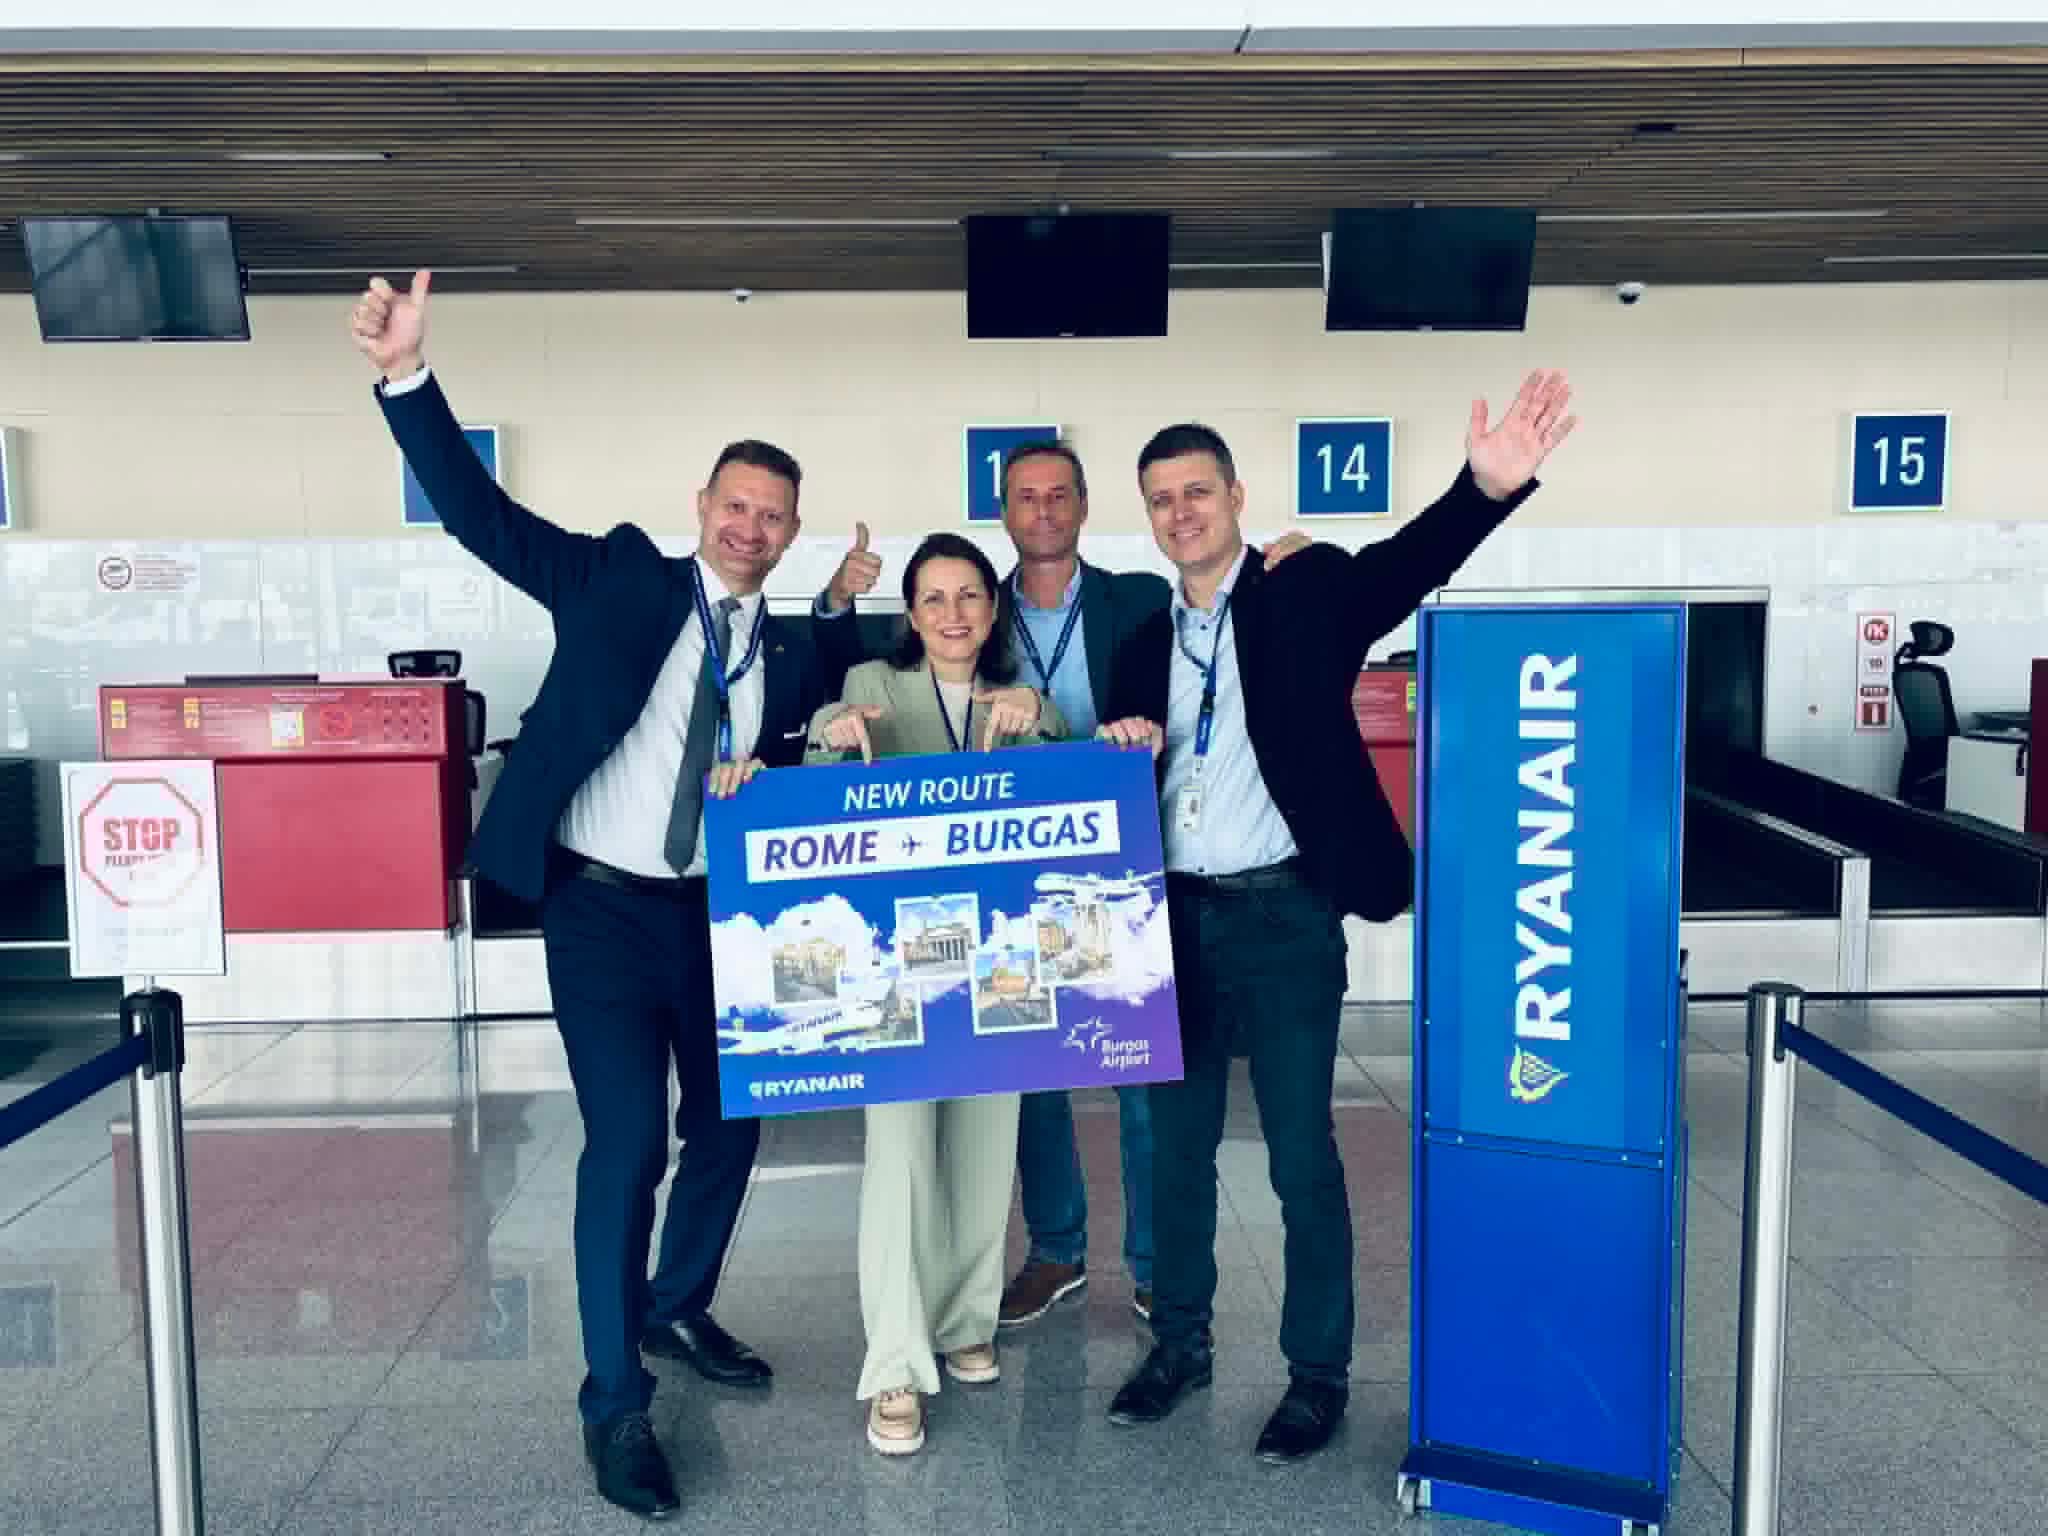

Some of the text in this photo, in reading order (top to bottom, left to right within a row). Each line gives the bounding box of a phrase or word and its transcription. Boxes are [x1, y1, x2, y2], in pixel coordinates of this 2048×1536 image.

[985, 449, 1002, 499] 1
[1317, 443, 1370, 494] 14
[1872, 436, 1926, 487] 15
[843, 771, 1015, 812] NEW ROUTE
[103, 818, 180, 850] STOP
[763, 811, 1101, 872] ROME BURGAS
[1515, 653, 1577, 1041] RYANAIR
[1100, 1054, 1151, 1071] Airport
[1102, 1039, 1150, 1056] Burgas
[764, 1073, 865, 1098] RYANAIR
